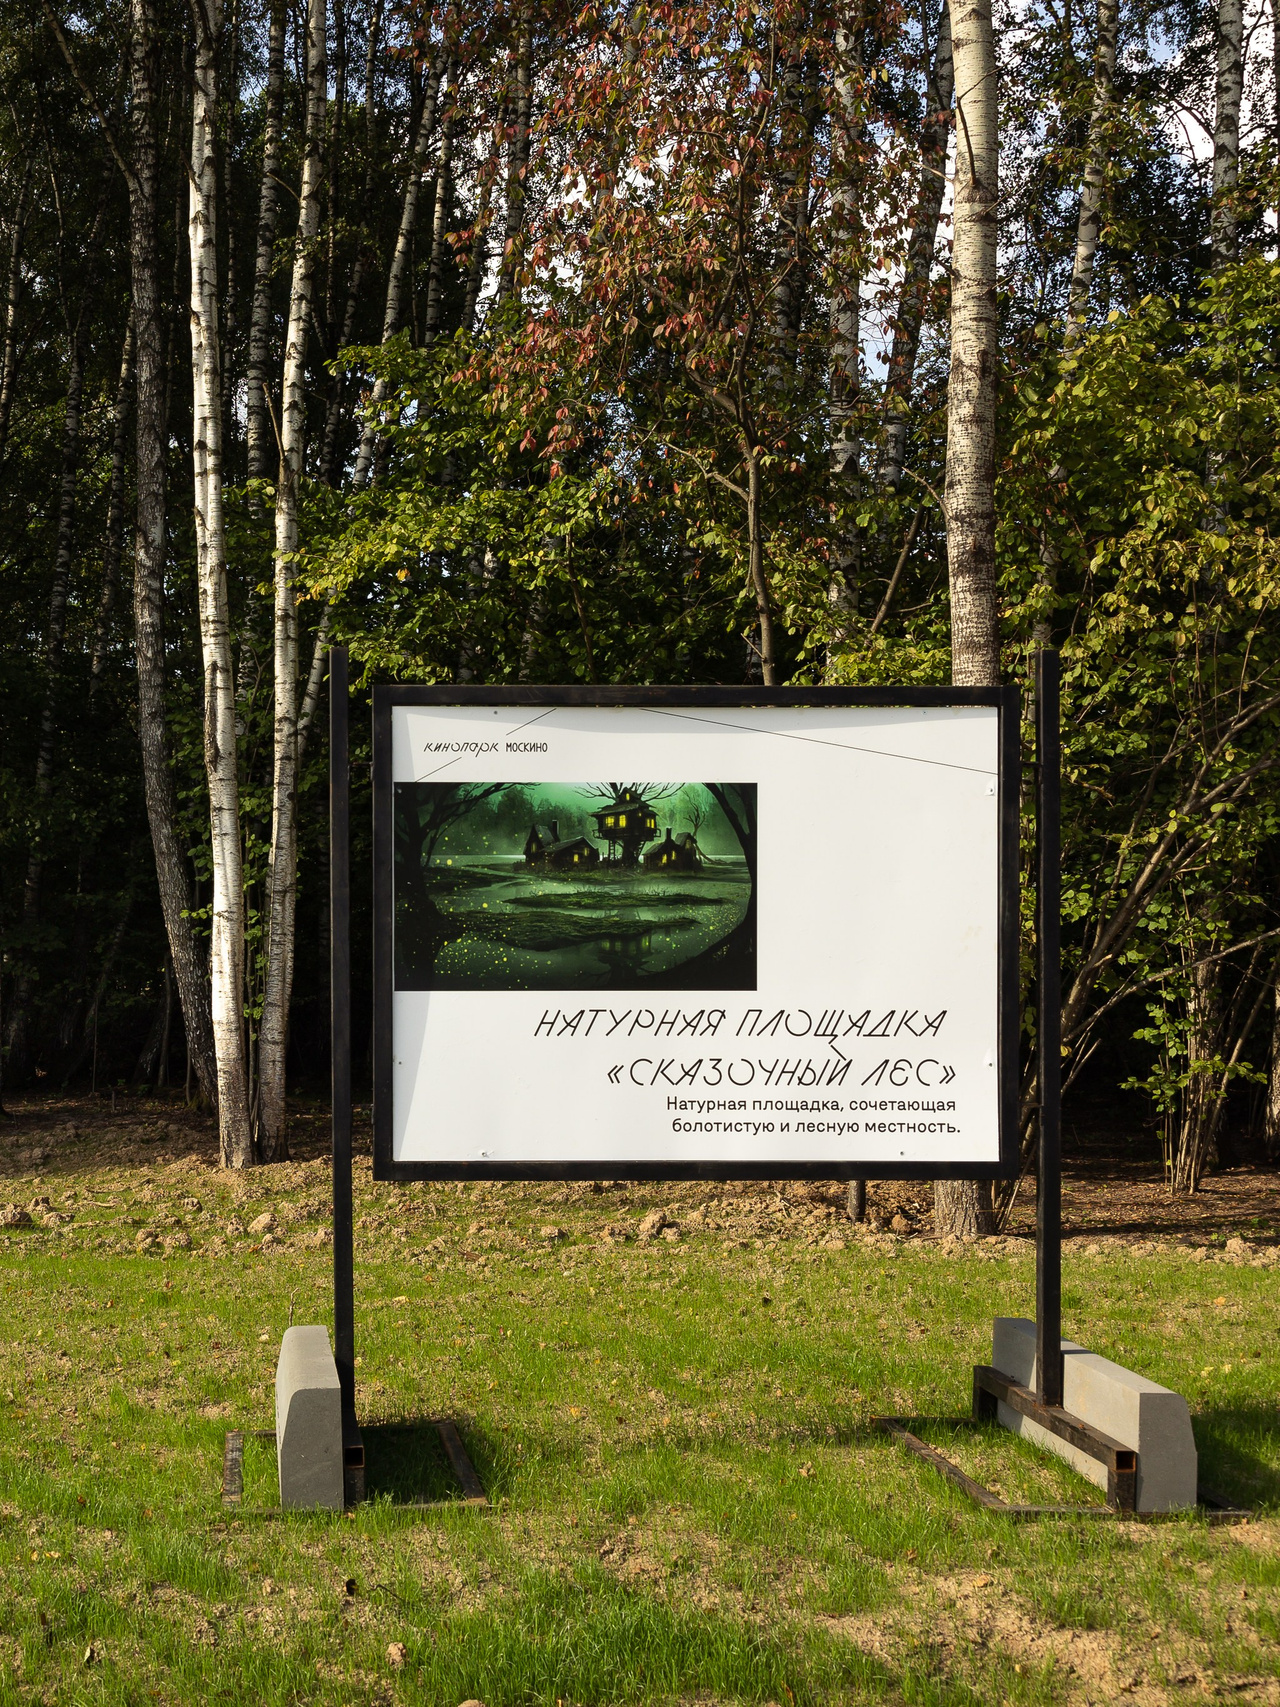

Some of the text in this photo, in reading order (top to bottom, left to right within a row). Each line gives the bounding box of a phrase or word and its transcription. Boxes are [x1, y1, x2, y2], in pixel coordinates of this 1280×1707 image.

[505, 742, 549, 753] МОСКИНО
[533, 1009, 948, 1044] НАТУРНАЯ ПЛОЩАДКА
[667, 1095, 956, 1114] Натурная площадка, сочетающая
[672, 1117, 962, 1136] болотистую и лесную местность.
